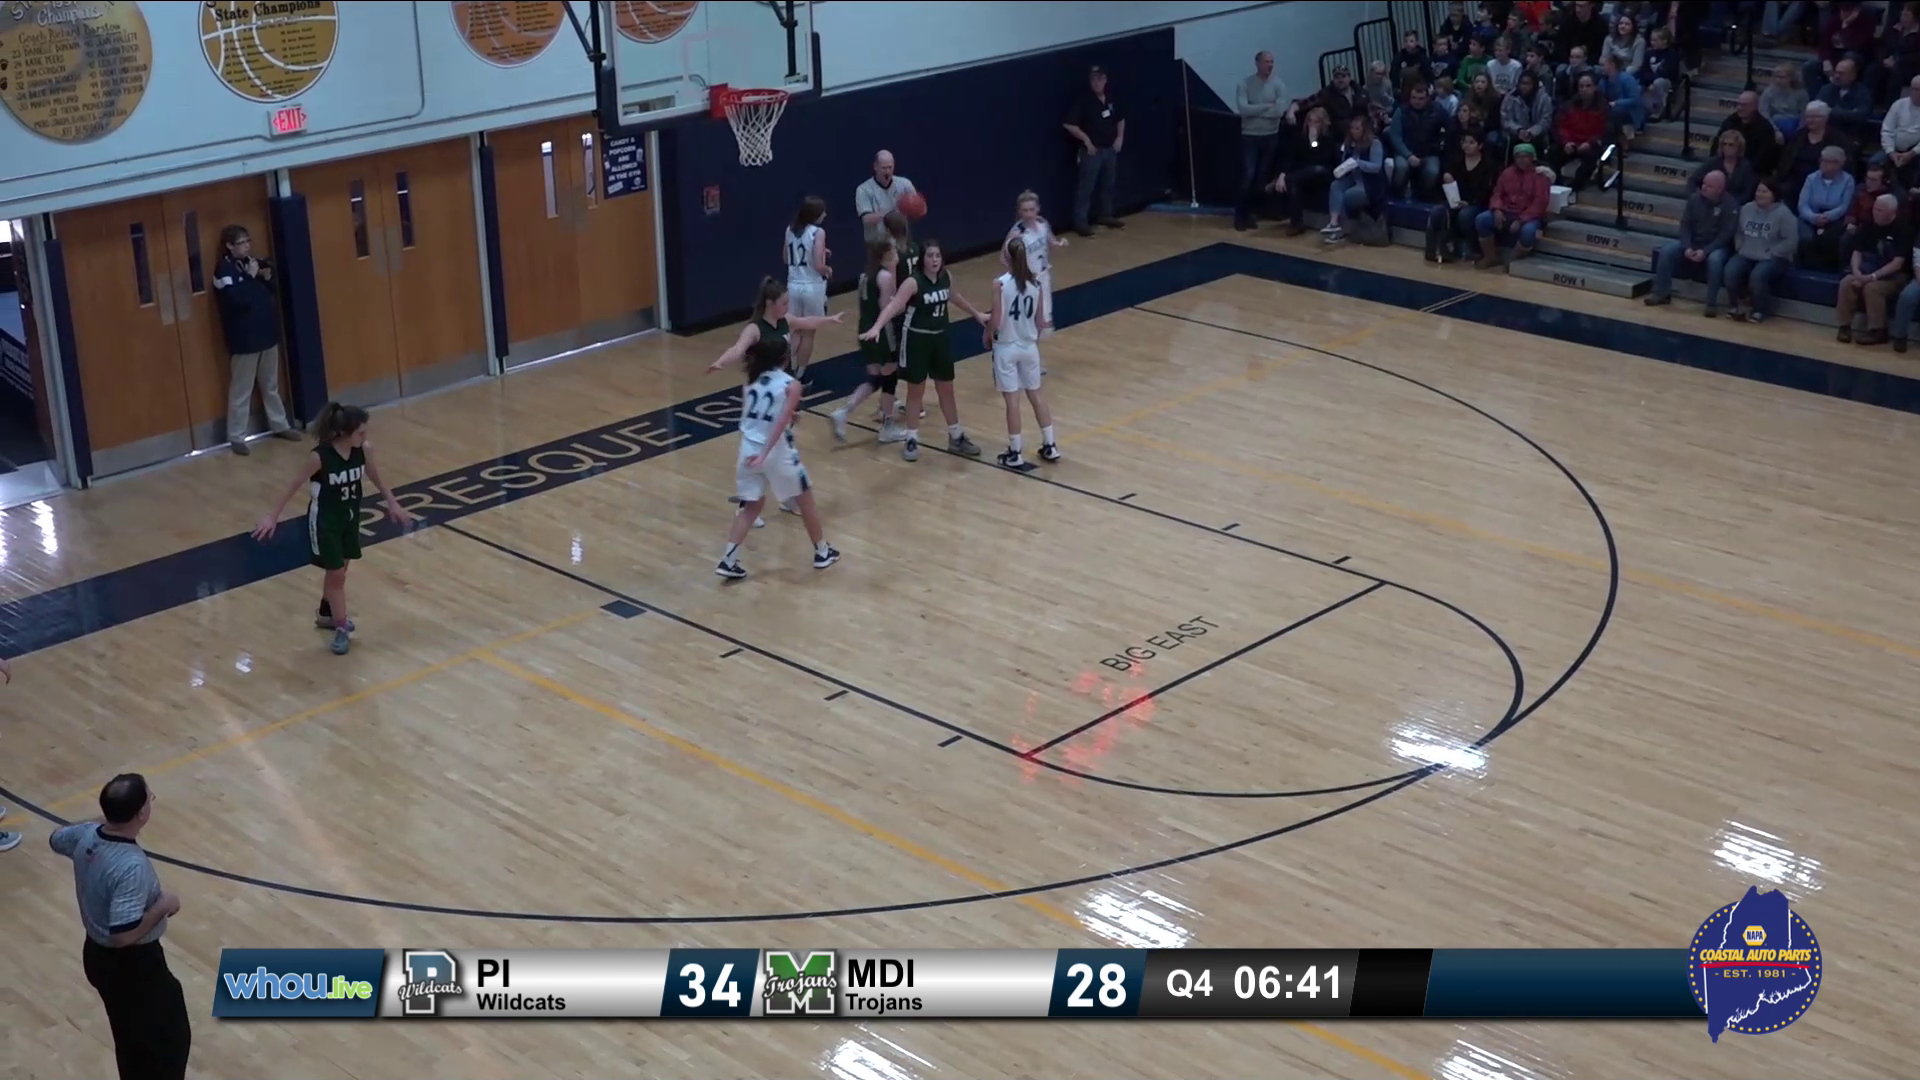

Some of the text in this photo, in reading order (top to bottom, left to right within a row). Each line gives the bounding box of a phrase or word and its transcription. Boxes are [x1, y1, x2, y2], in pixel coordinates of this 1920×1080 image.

[215, 1, 320, 21] State Champions
[278, 107, 302, 132] EXIT
[609, 145, 636, 156] POPCORN
[618, 155, 629, 163] ARE
[611, 162, 638, 172] ALLOWED
[1653, 165, 1687, 178] ROW 4
[616, 172, 627, 180] THE
[1586, 233, 1619, 247] ROW 2
[788, 242, 807, 266] 12
[1553, 273, 1585, 287] ROW 1
[1009, 295, 1033, 321] 40
[748, 389, 773, 422] 22
[359, 421, 692, 536] PRESQUE
[1100, 616, 1219, 671] BIG EAST
